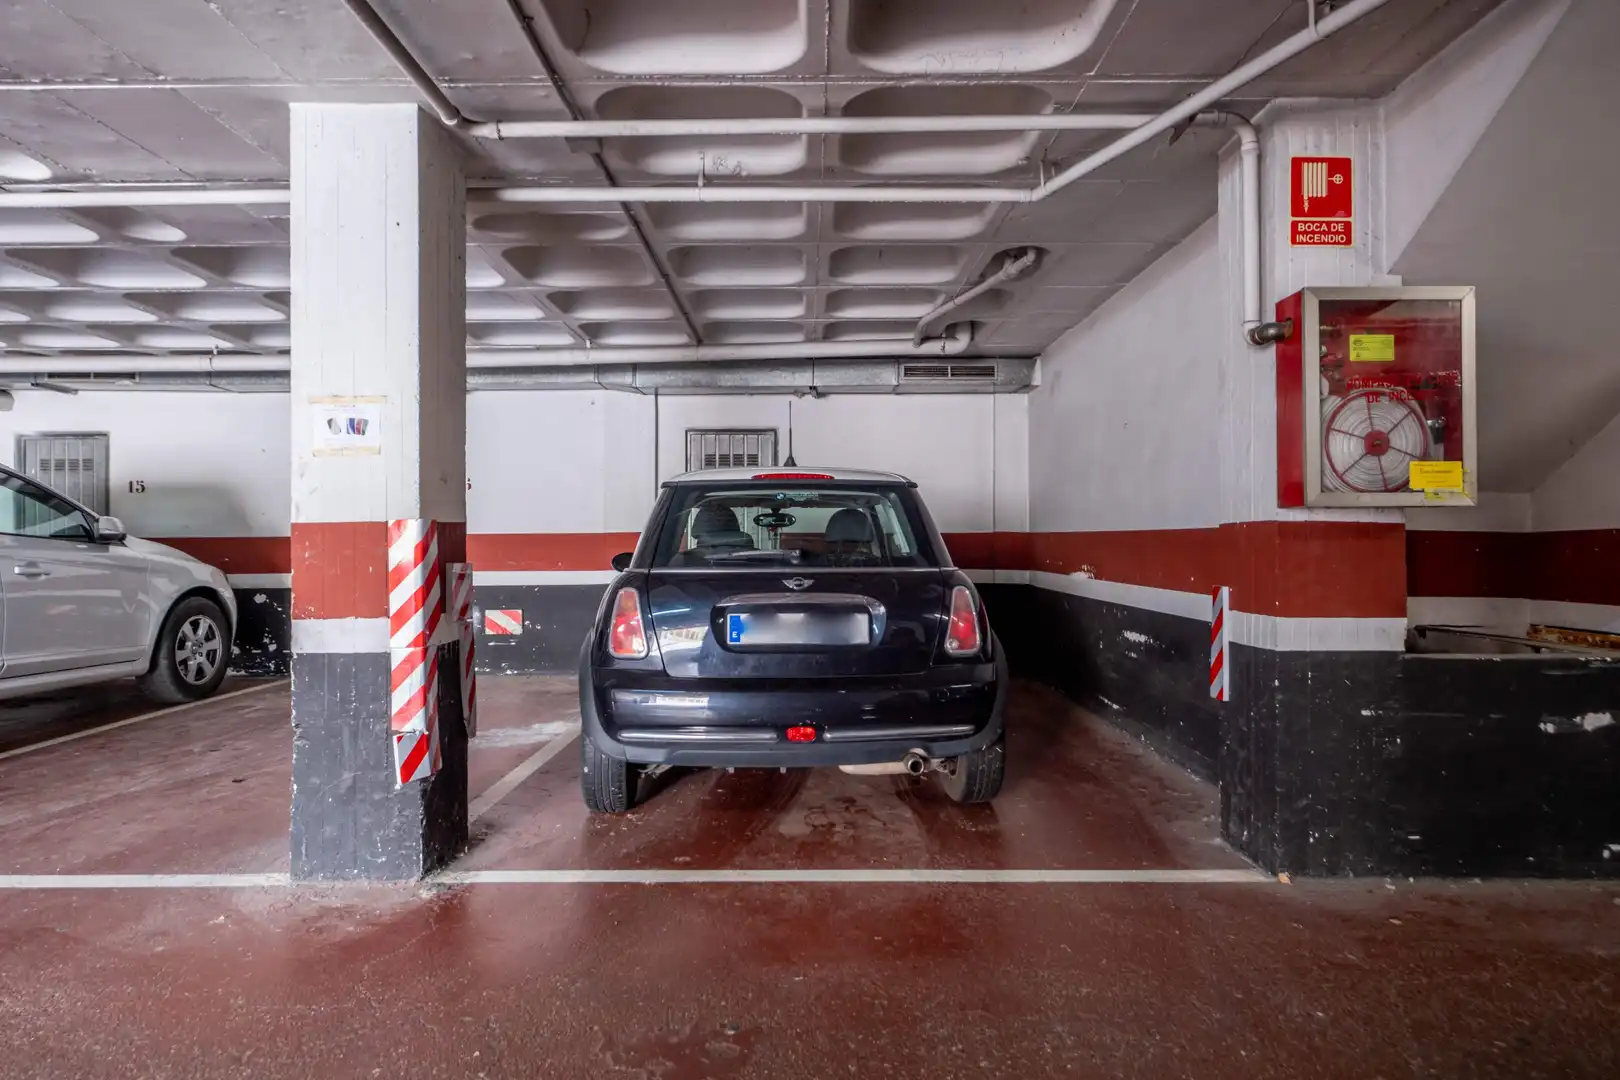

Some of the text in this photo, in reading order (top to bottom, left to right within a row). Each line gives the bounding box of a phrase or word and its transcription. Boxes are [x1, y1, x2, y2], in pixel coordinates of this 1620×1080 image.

[1297, 222, 1345, 232] BOCA DE
[1296, 234, 1347, 243] INCENDIO
[128, 480, 146, 494] 15
